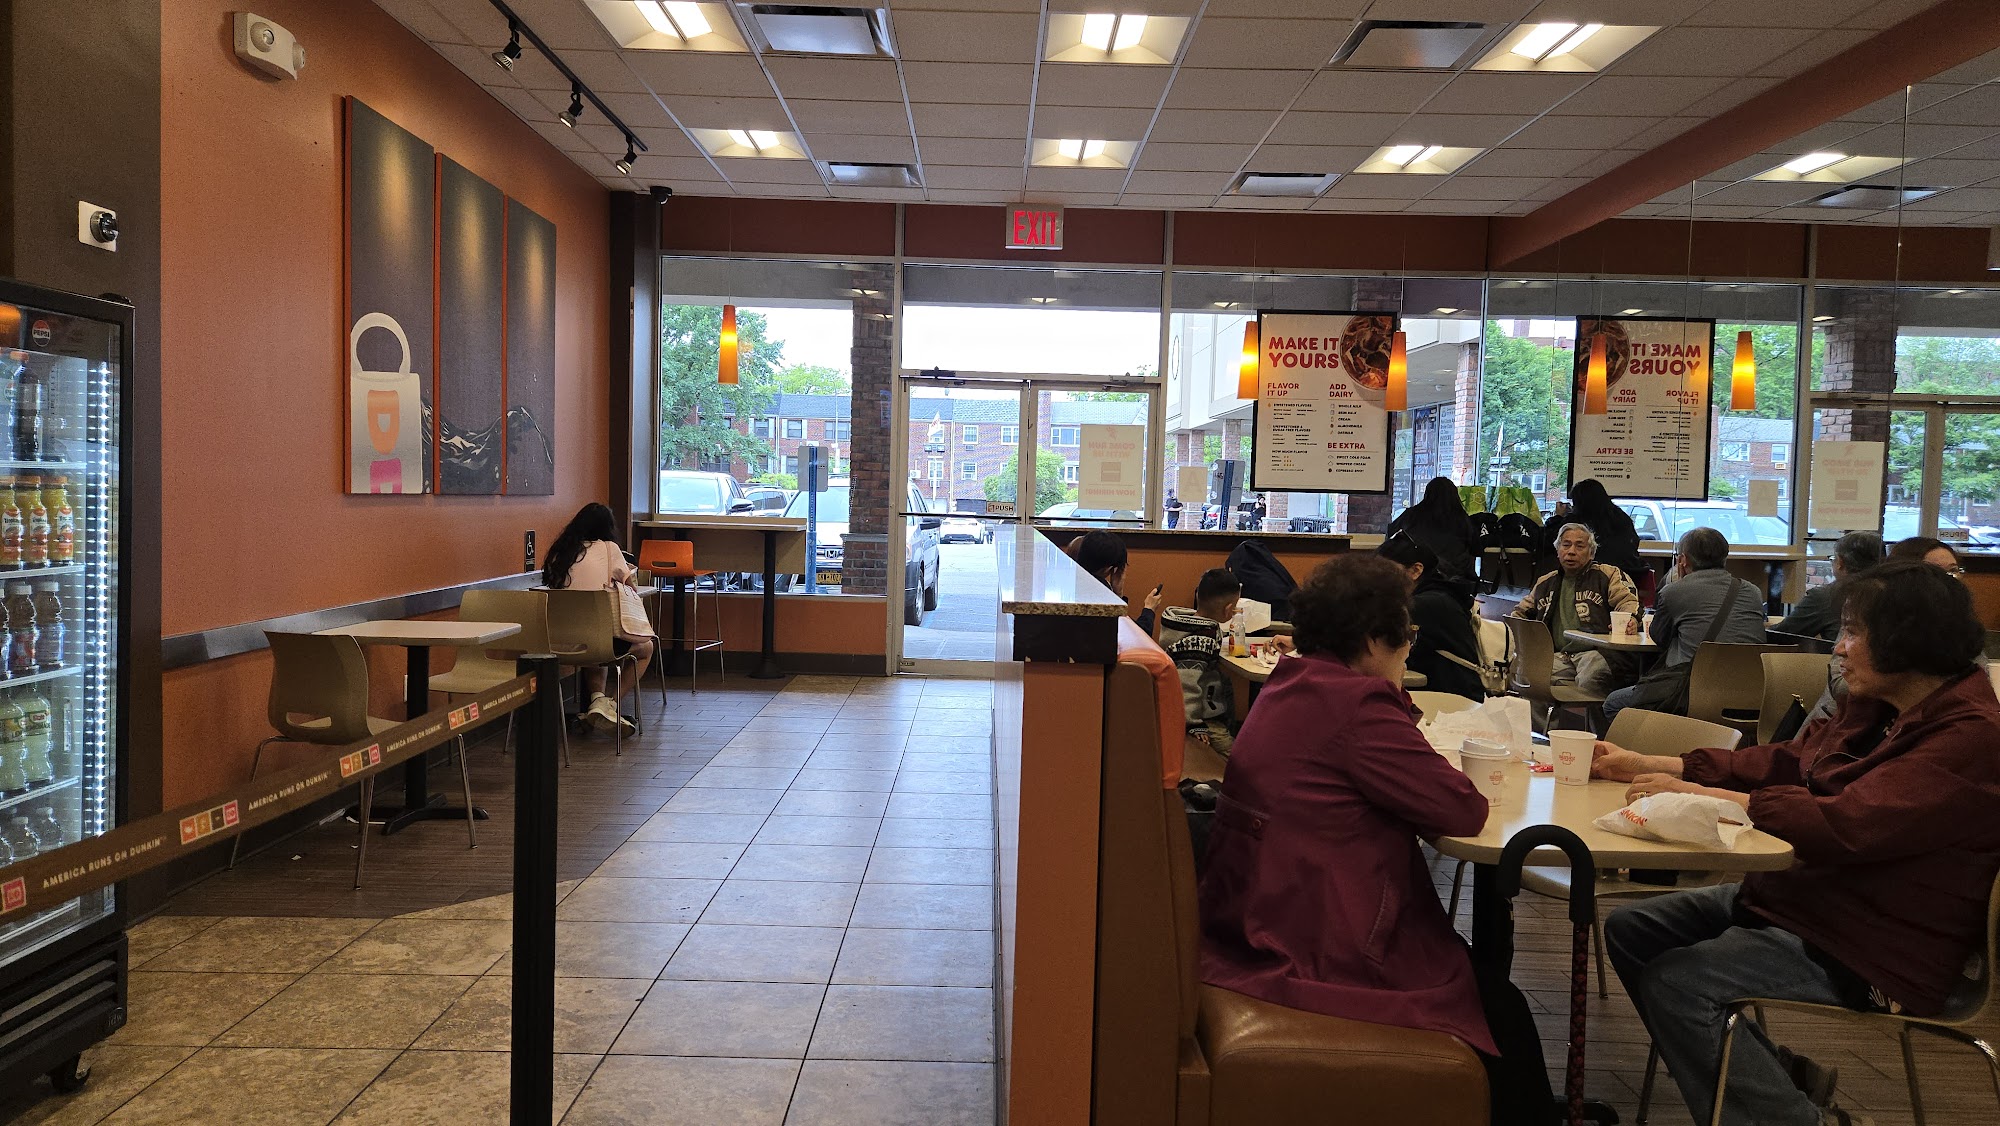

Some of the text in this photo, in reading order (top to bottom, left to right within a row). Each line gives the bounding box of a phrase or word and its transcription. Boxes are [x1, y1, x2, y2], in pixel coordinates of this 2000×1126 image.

[1013, 210, 1060, 246] EXIT
[33, 329, 50, 338] PEPSI
[1268, 336, 1340, 351] MAKE IT
[1268, 352, 1340, 369] YOURS
[386, 739, 407, 753] AMERICA
[406, 733, 418, 745] RUNS
[418, 731, 425, 740] ON
[248, 793, 279, 811] AMERICA
[279, 784, 295, 798] RUNS
[295, 780, 305, 792] ON
[42, 836, 163, 890] AMERICA RUNS ON DUNKIN'
